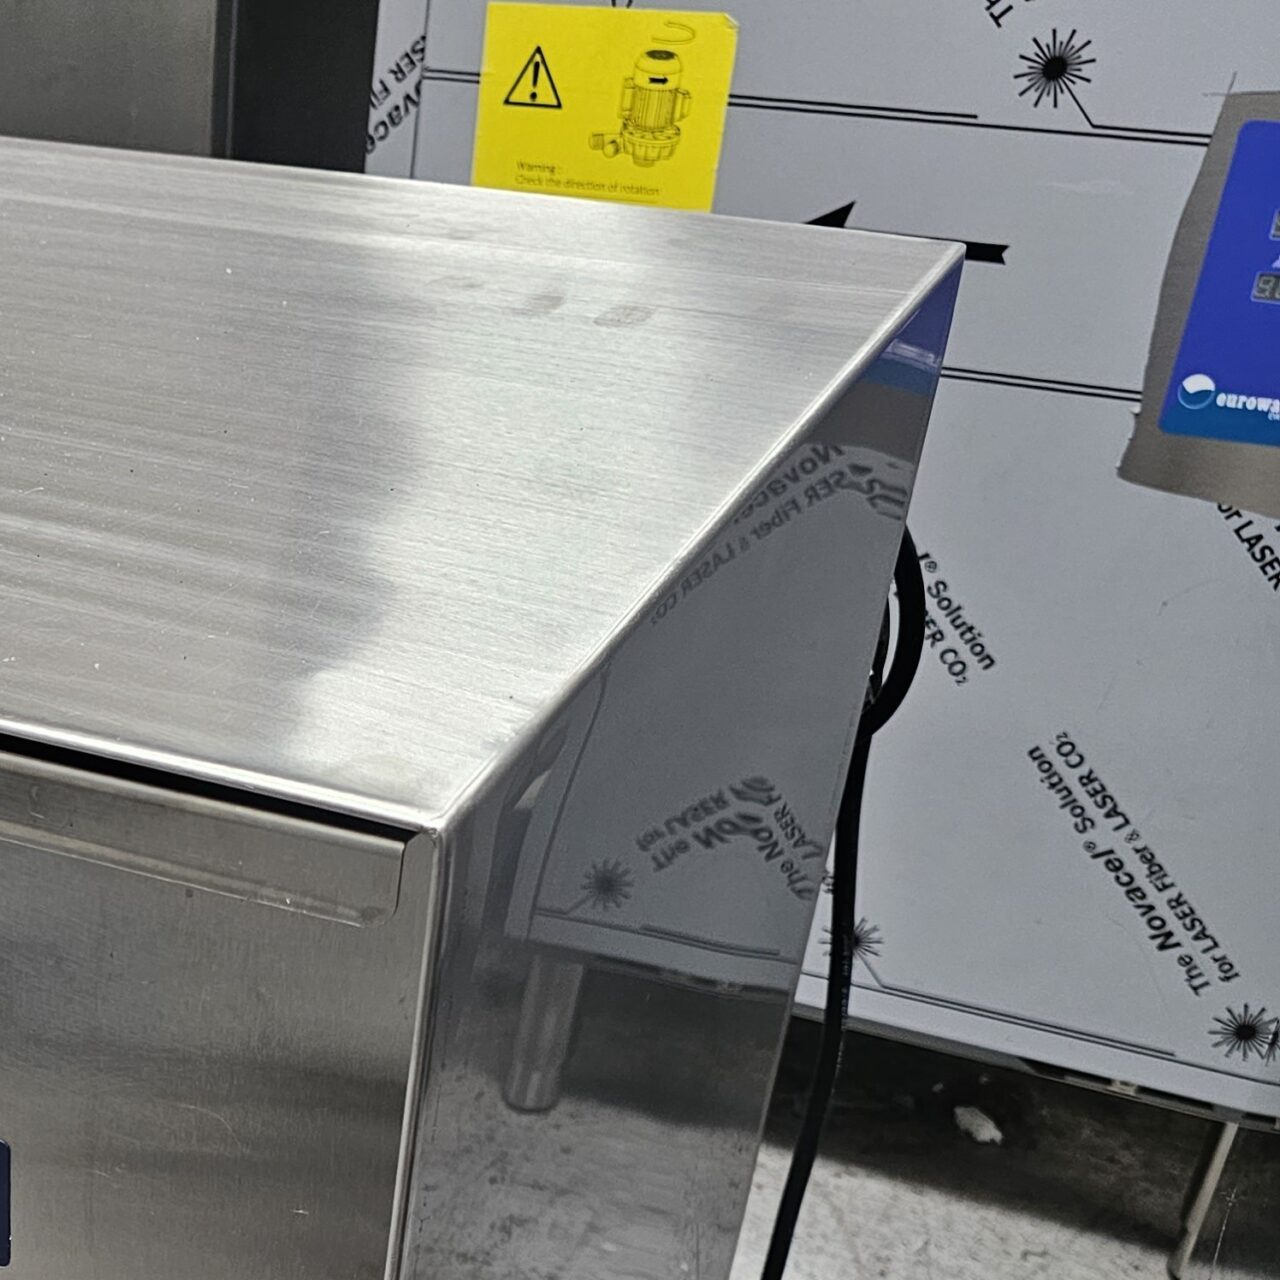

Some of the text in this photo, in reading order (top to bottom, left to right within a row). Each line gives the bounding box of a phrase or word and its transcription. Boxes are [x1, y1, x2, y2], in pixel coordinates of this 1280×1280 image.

[927, 580, 995, 670] Solution
[1027, 746, 1096, 834] Solution
[1078, 768, 1131, 832] LASER
[1125, 830, 1141, 843] &
[1133, 846, 1175, 894] Fiber
[1166, 892, 1219, 954] LASER
[1177, 953, 1211, 997] The
[1210, 954, 1240, 983] for
